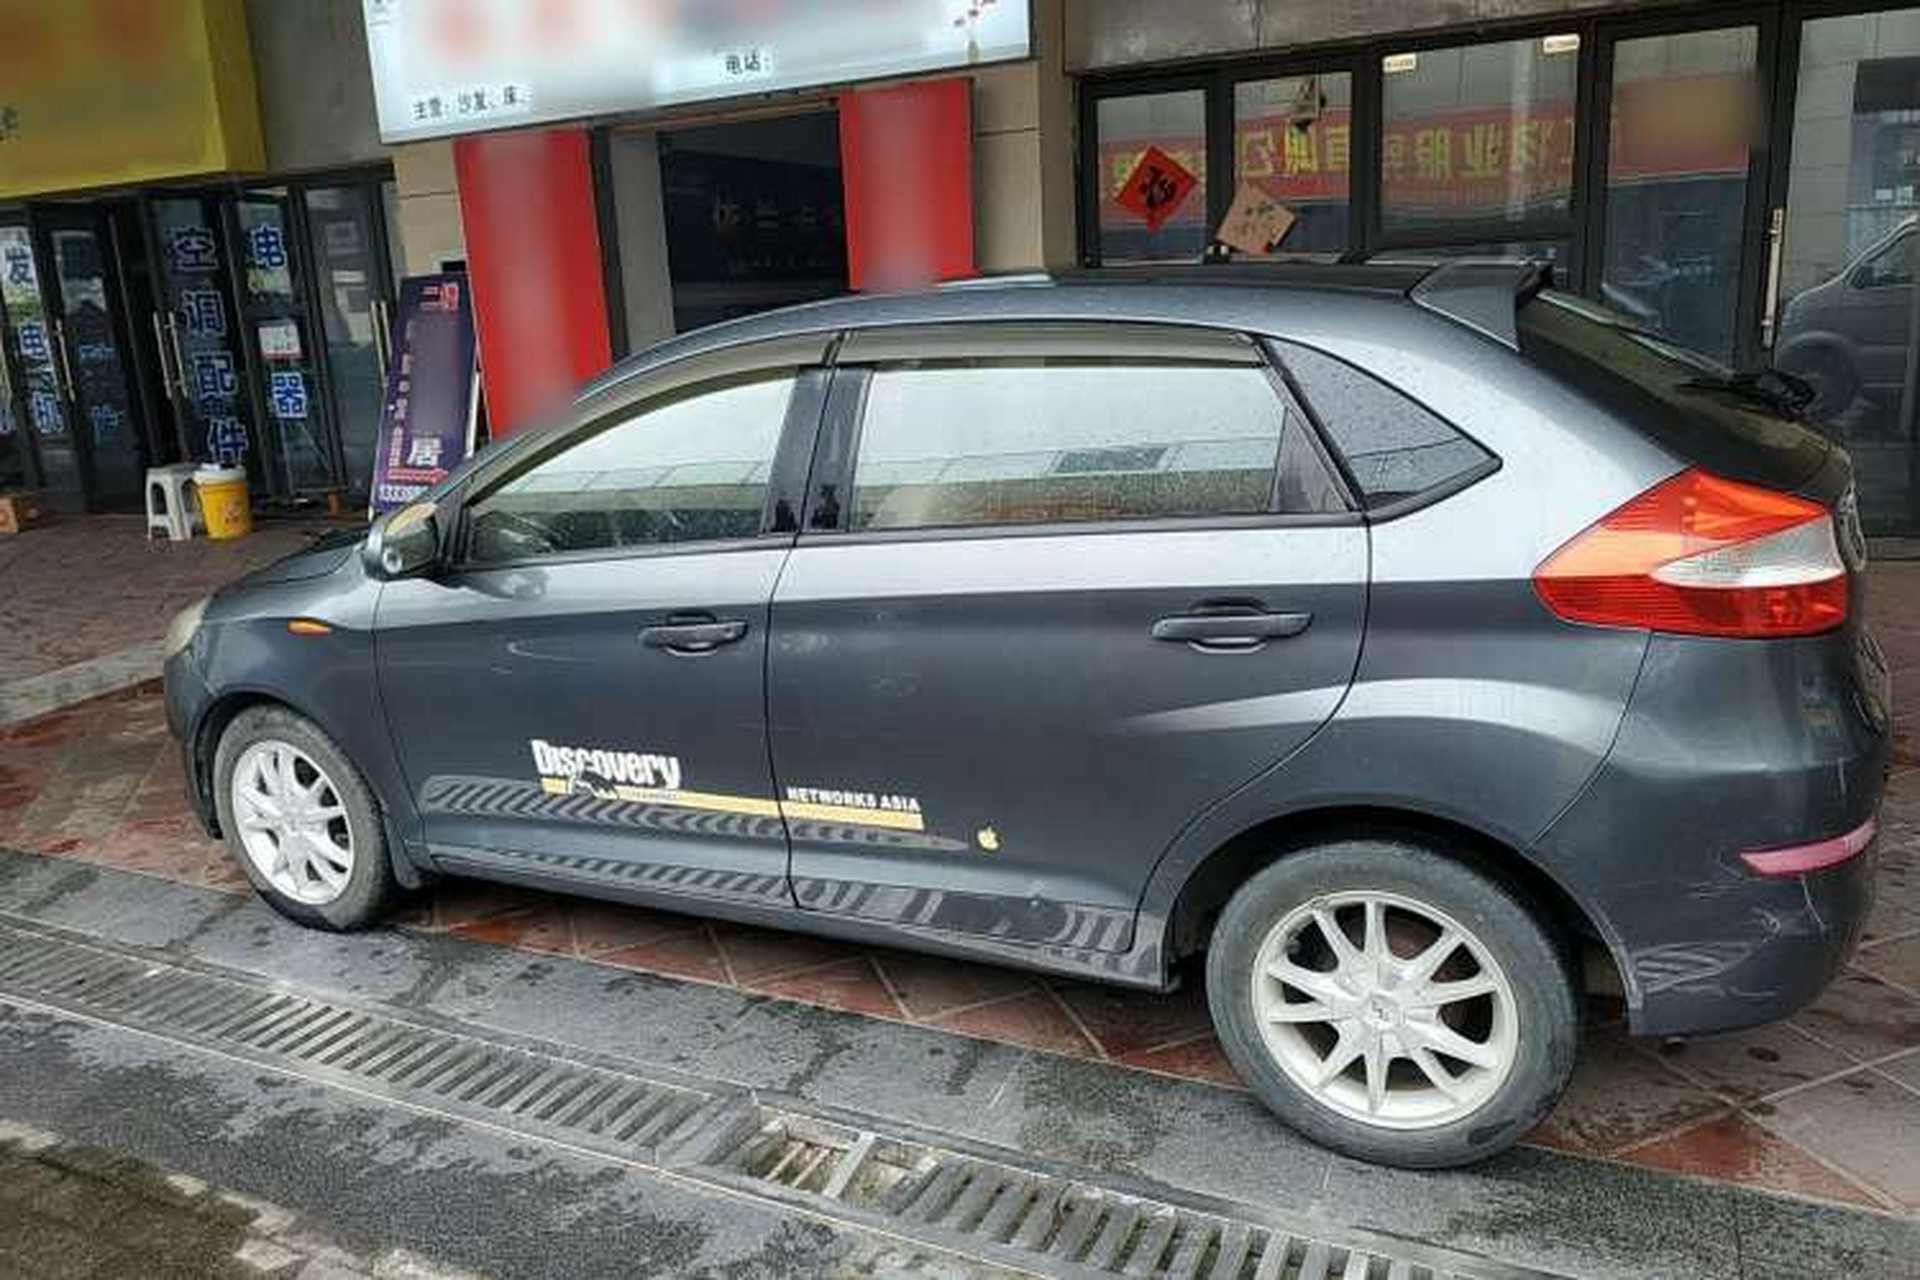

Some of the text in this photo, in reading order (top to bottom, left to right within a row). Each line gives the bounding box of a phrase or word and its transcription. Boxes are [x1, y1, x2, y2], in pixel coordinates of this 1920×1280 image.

[531, 739, 682, 790] Discovery
[786, 785, 922, 813] NETWORKS ASIA
